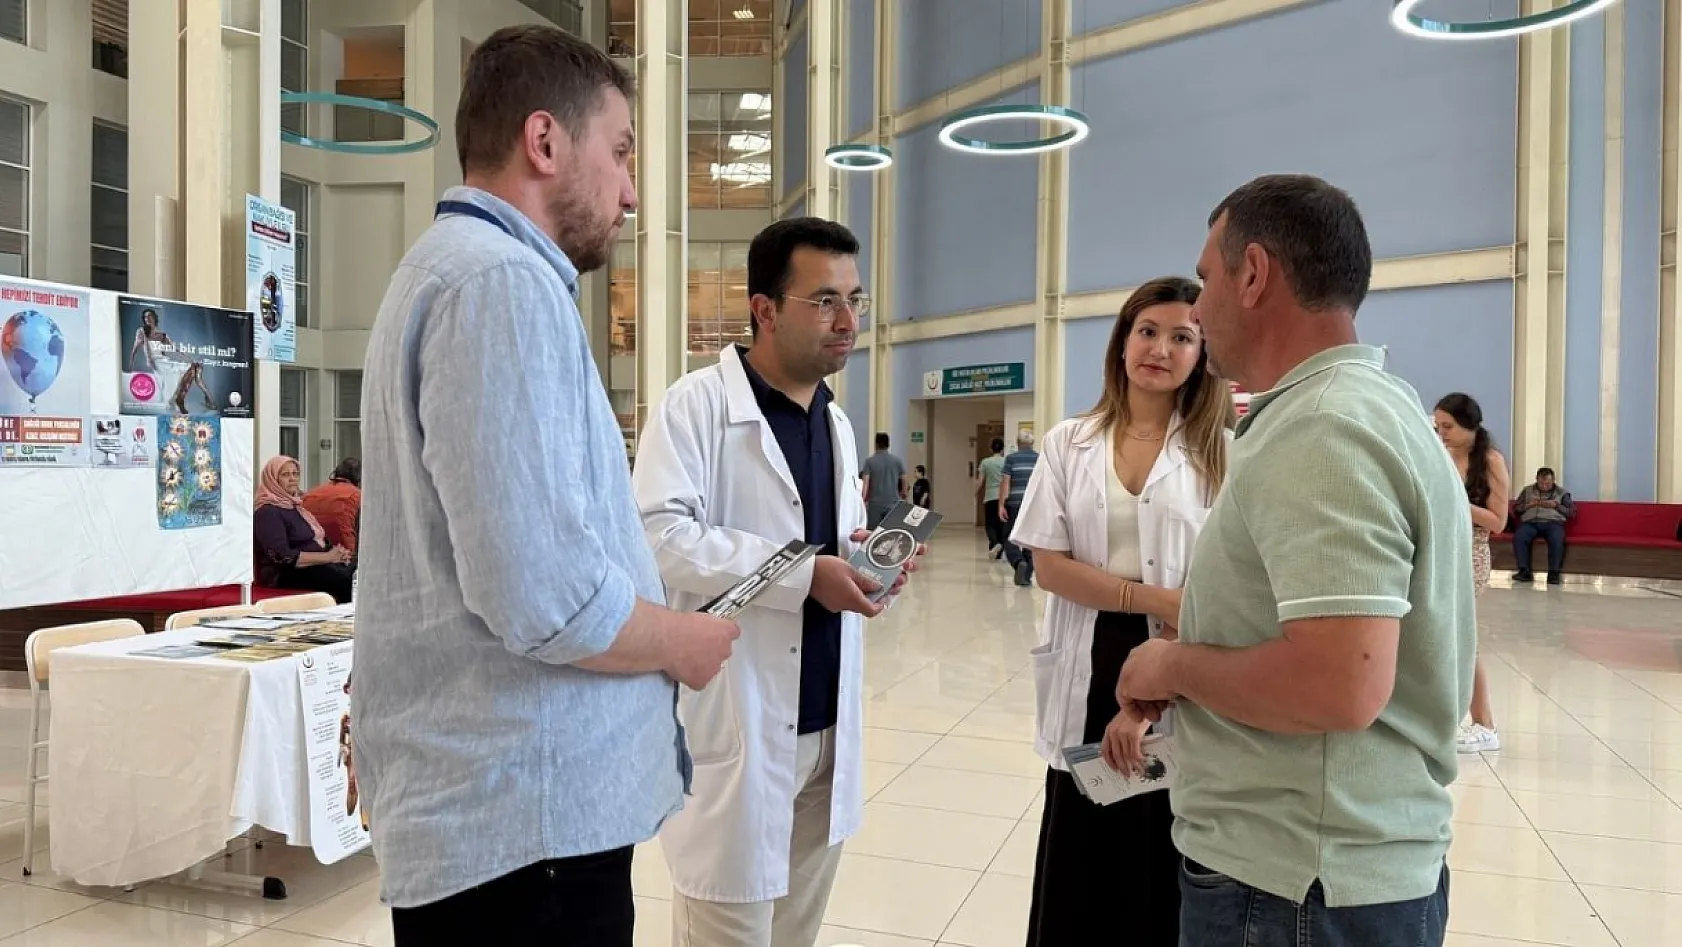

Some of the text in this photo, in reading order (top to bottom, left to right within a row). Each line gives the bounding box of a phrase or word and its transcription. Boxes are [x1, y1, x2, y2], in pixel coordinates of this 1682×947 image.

[153, 342, 236, 357] Yeni bir stil mi?
